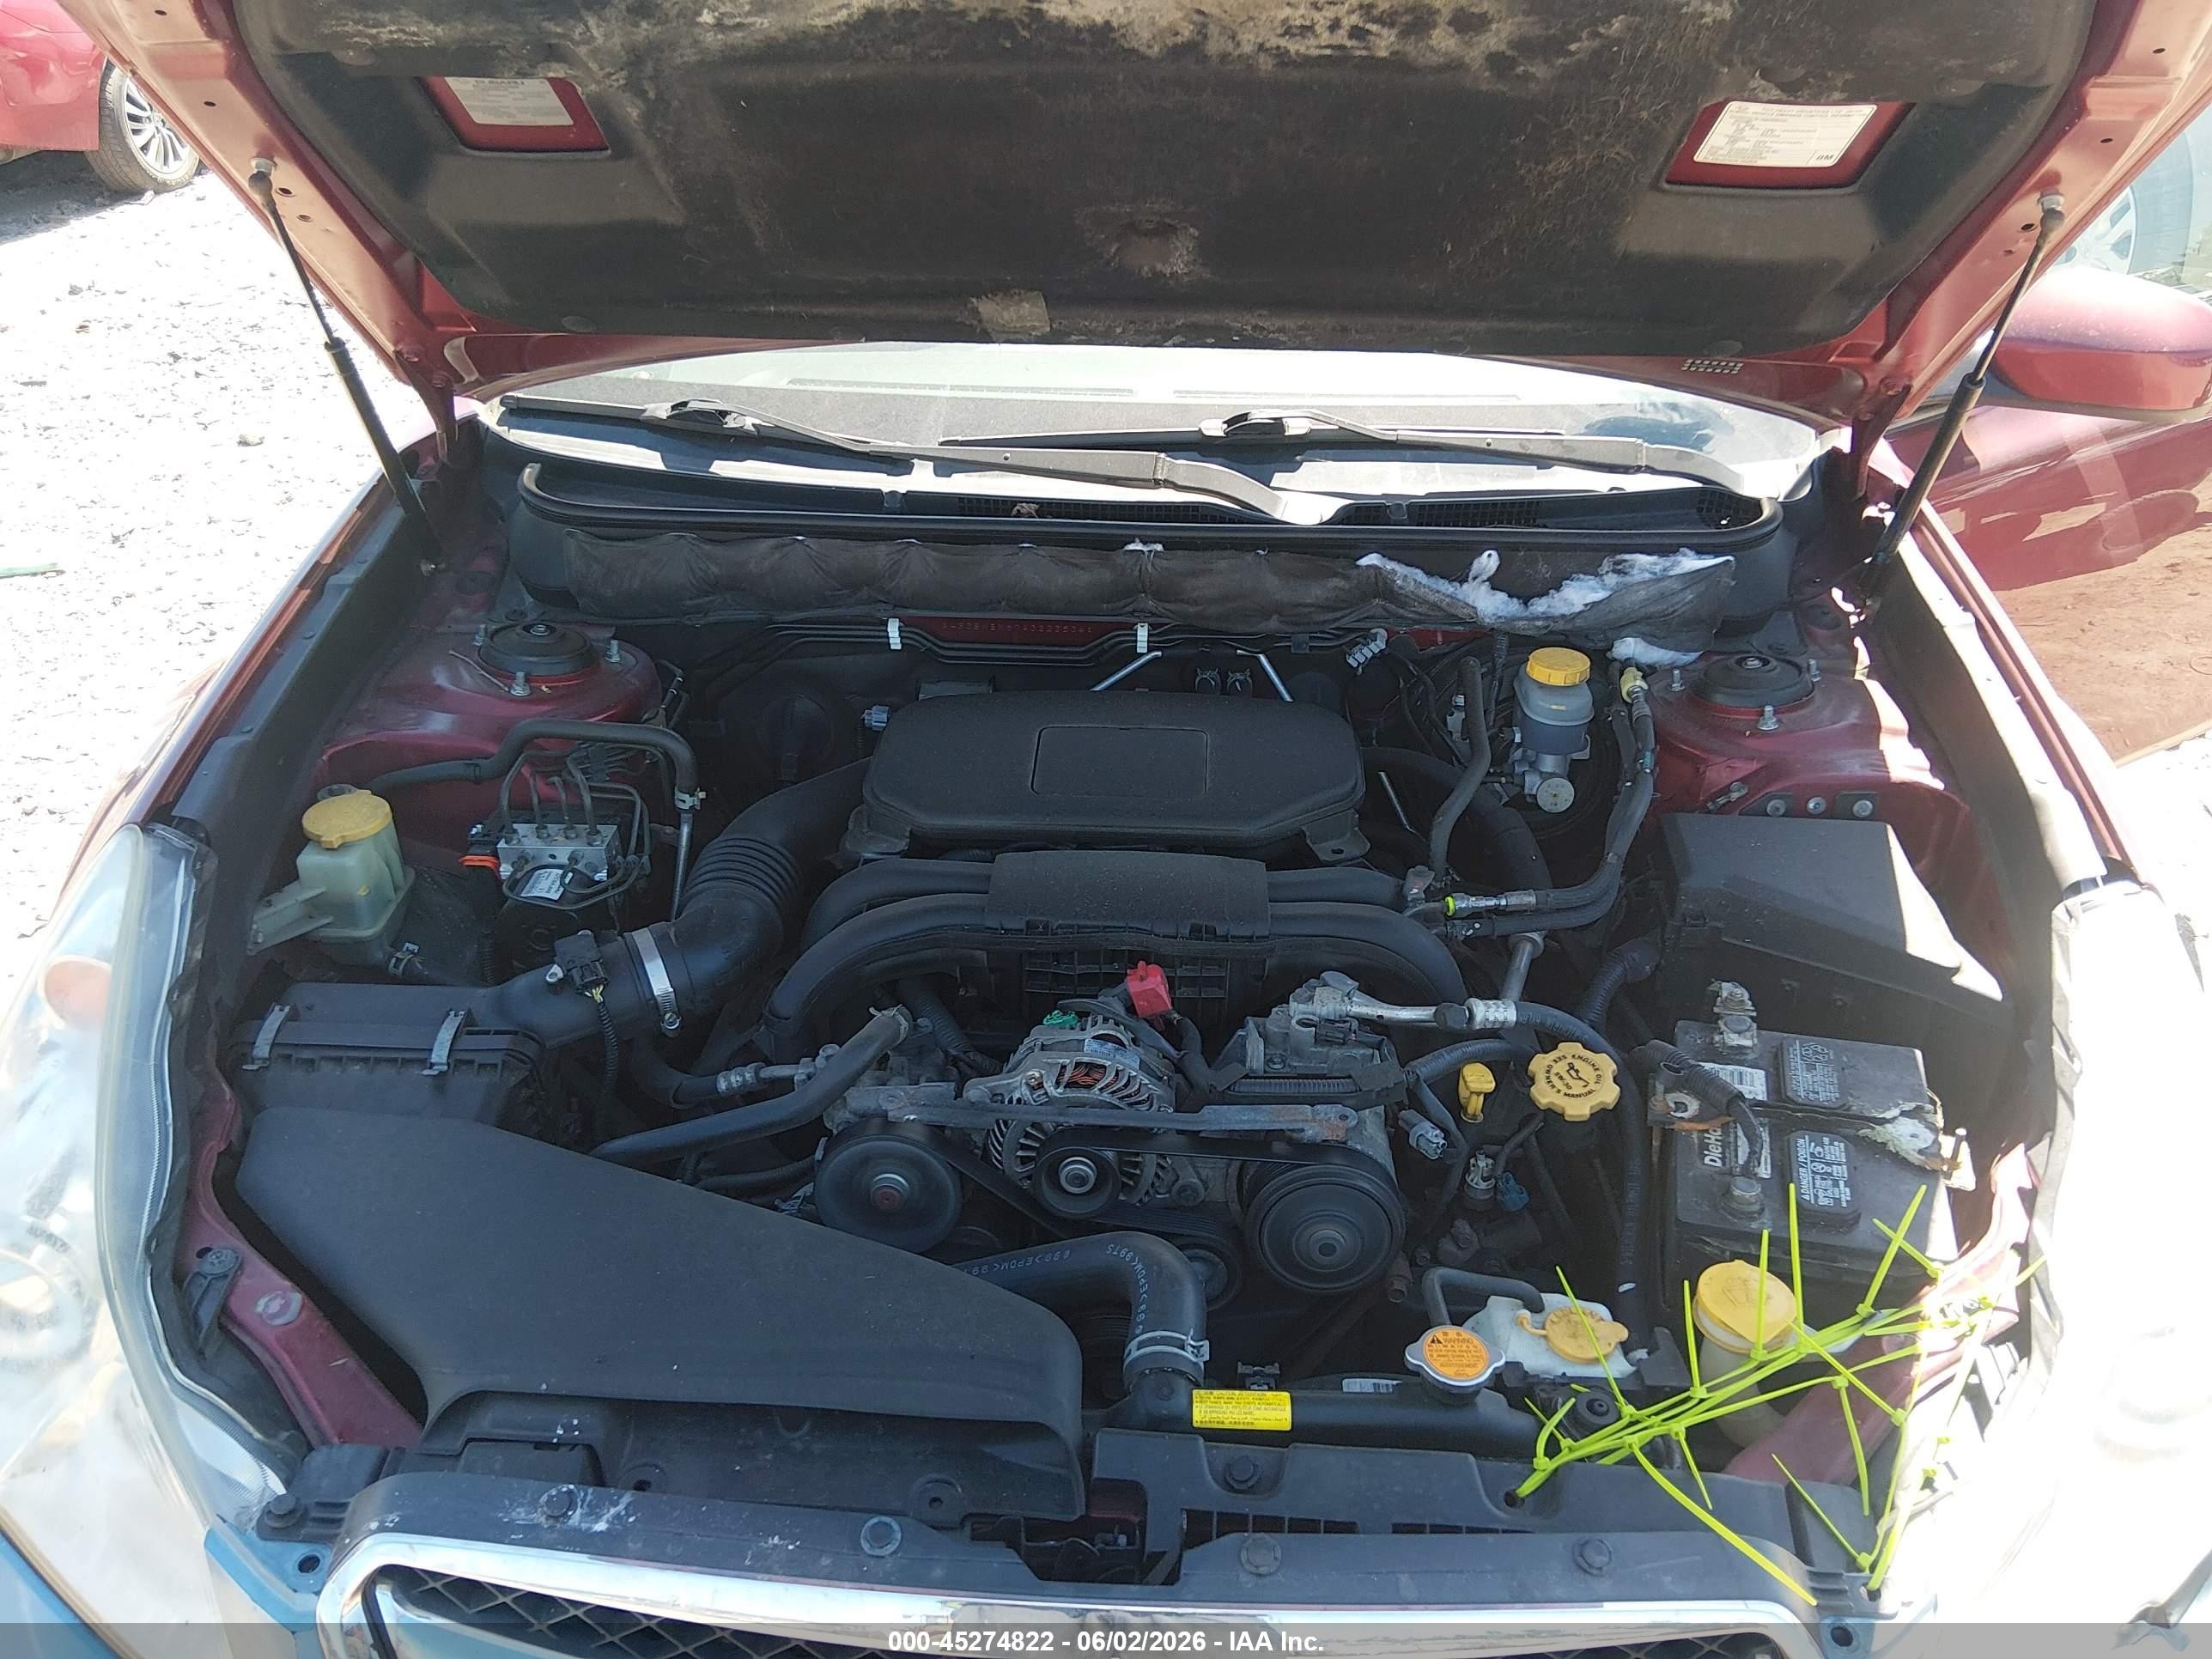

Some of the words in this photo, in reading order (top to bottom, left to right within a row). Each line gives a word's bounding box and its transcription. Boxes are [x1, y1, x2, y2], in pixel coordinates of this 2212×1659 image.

[1571, 1054, 1600, 1072] ENGINE
[1594, 1073, 1602, 1084] OIL
[1564, 1088, 1596, 1098] MANUAL
[1704, 1126, 1723, 1167] DieHa
[1796, 1138, 1808, 1163] POISON
[1798, 1167, 1809, 1194] DANGER
